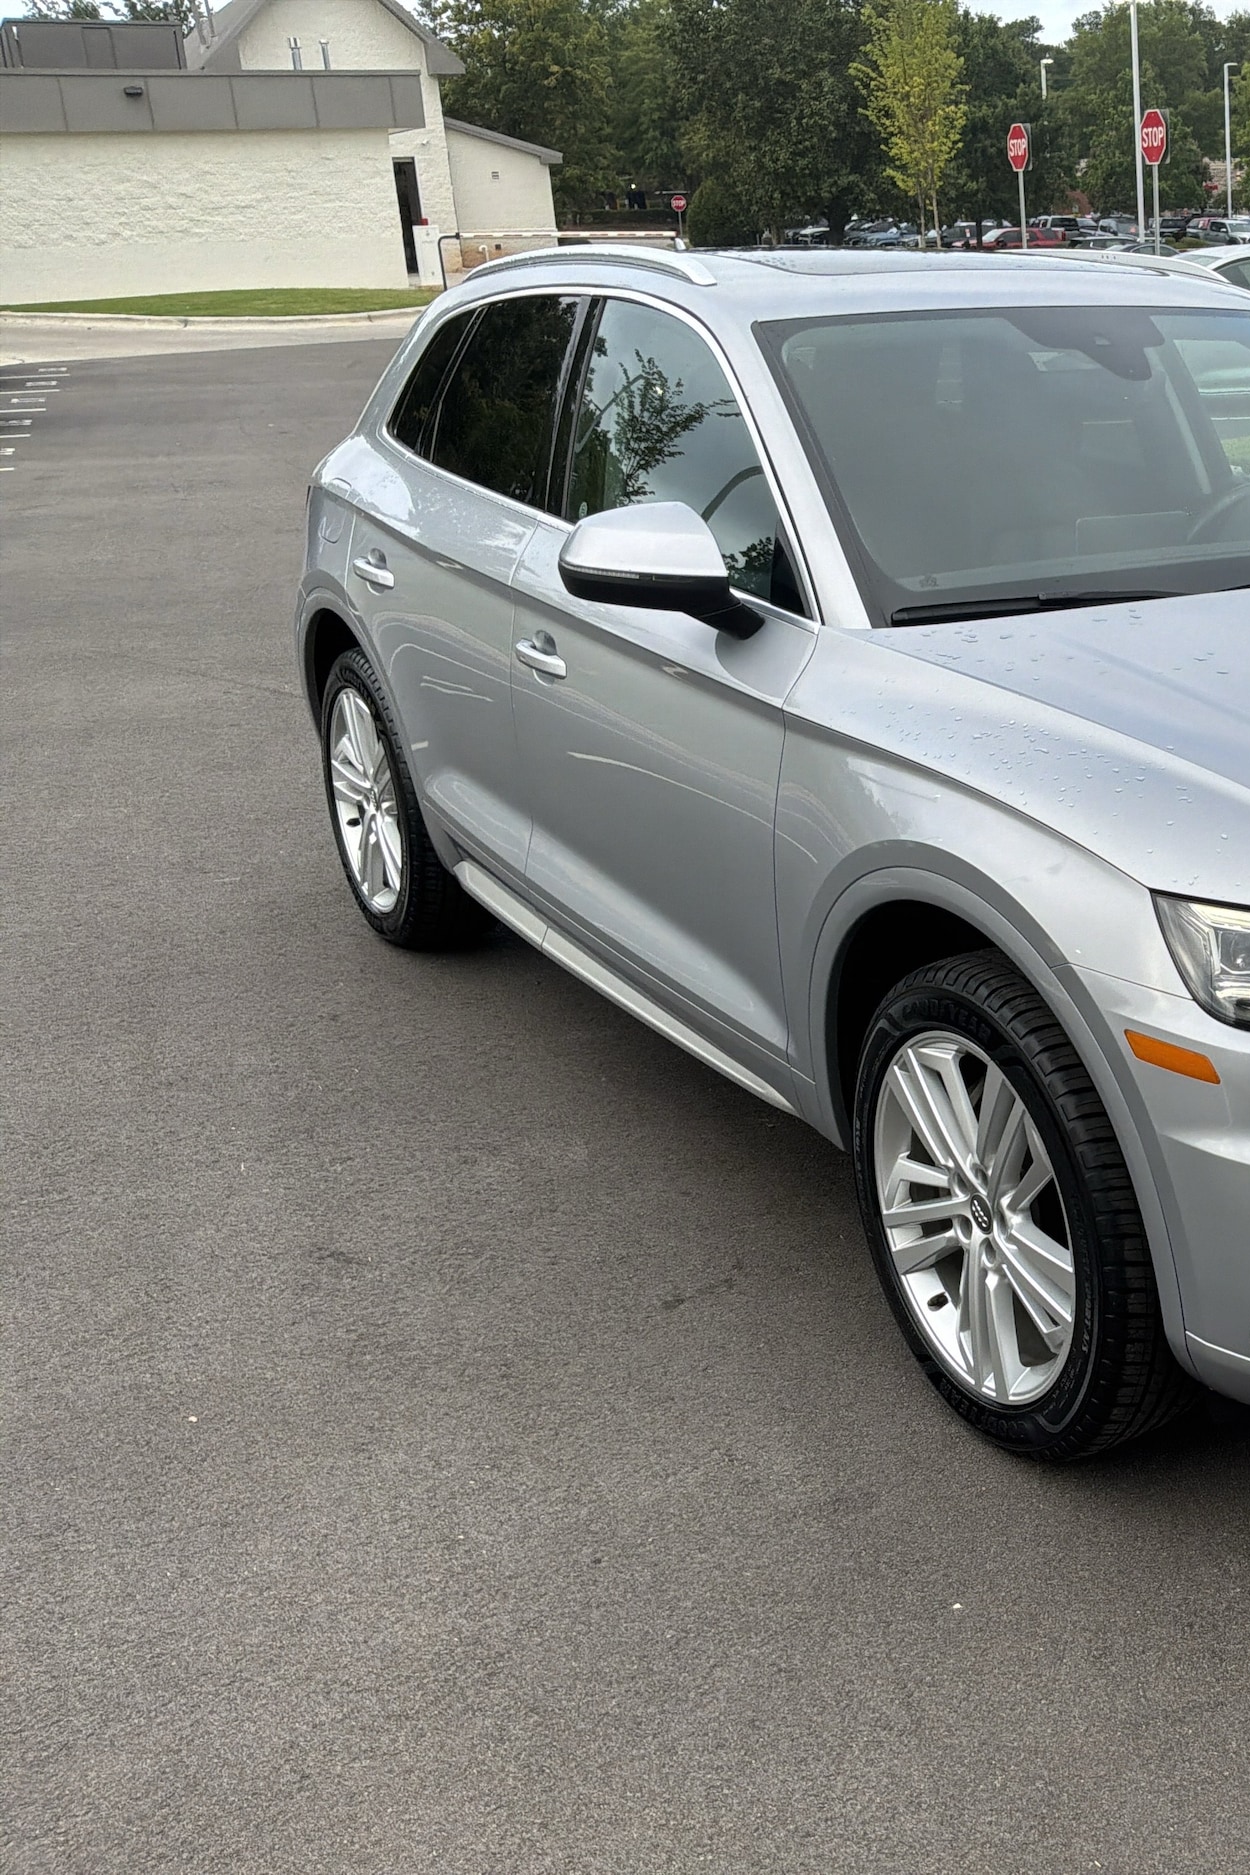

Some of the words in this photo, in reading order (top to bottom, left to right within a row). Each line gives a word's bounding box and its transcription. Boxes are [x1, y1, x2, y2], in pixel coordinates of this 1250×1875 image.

[1142, 127, 1164, 148] STOP
[1009, 138, 1026, 157] STOP
[672, 199, 685, 207] STOP
